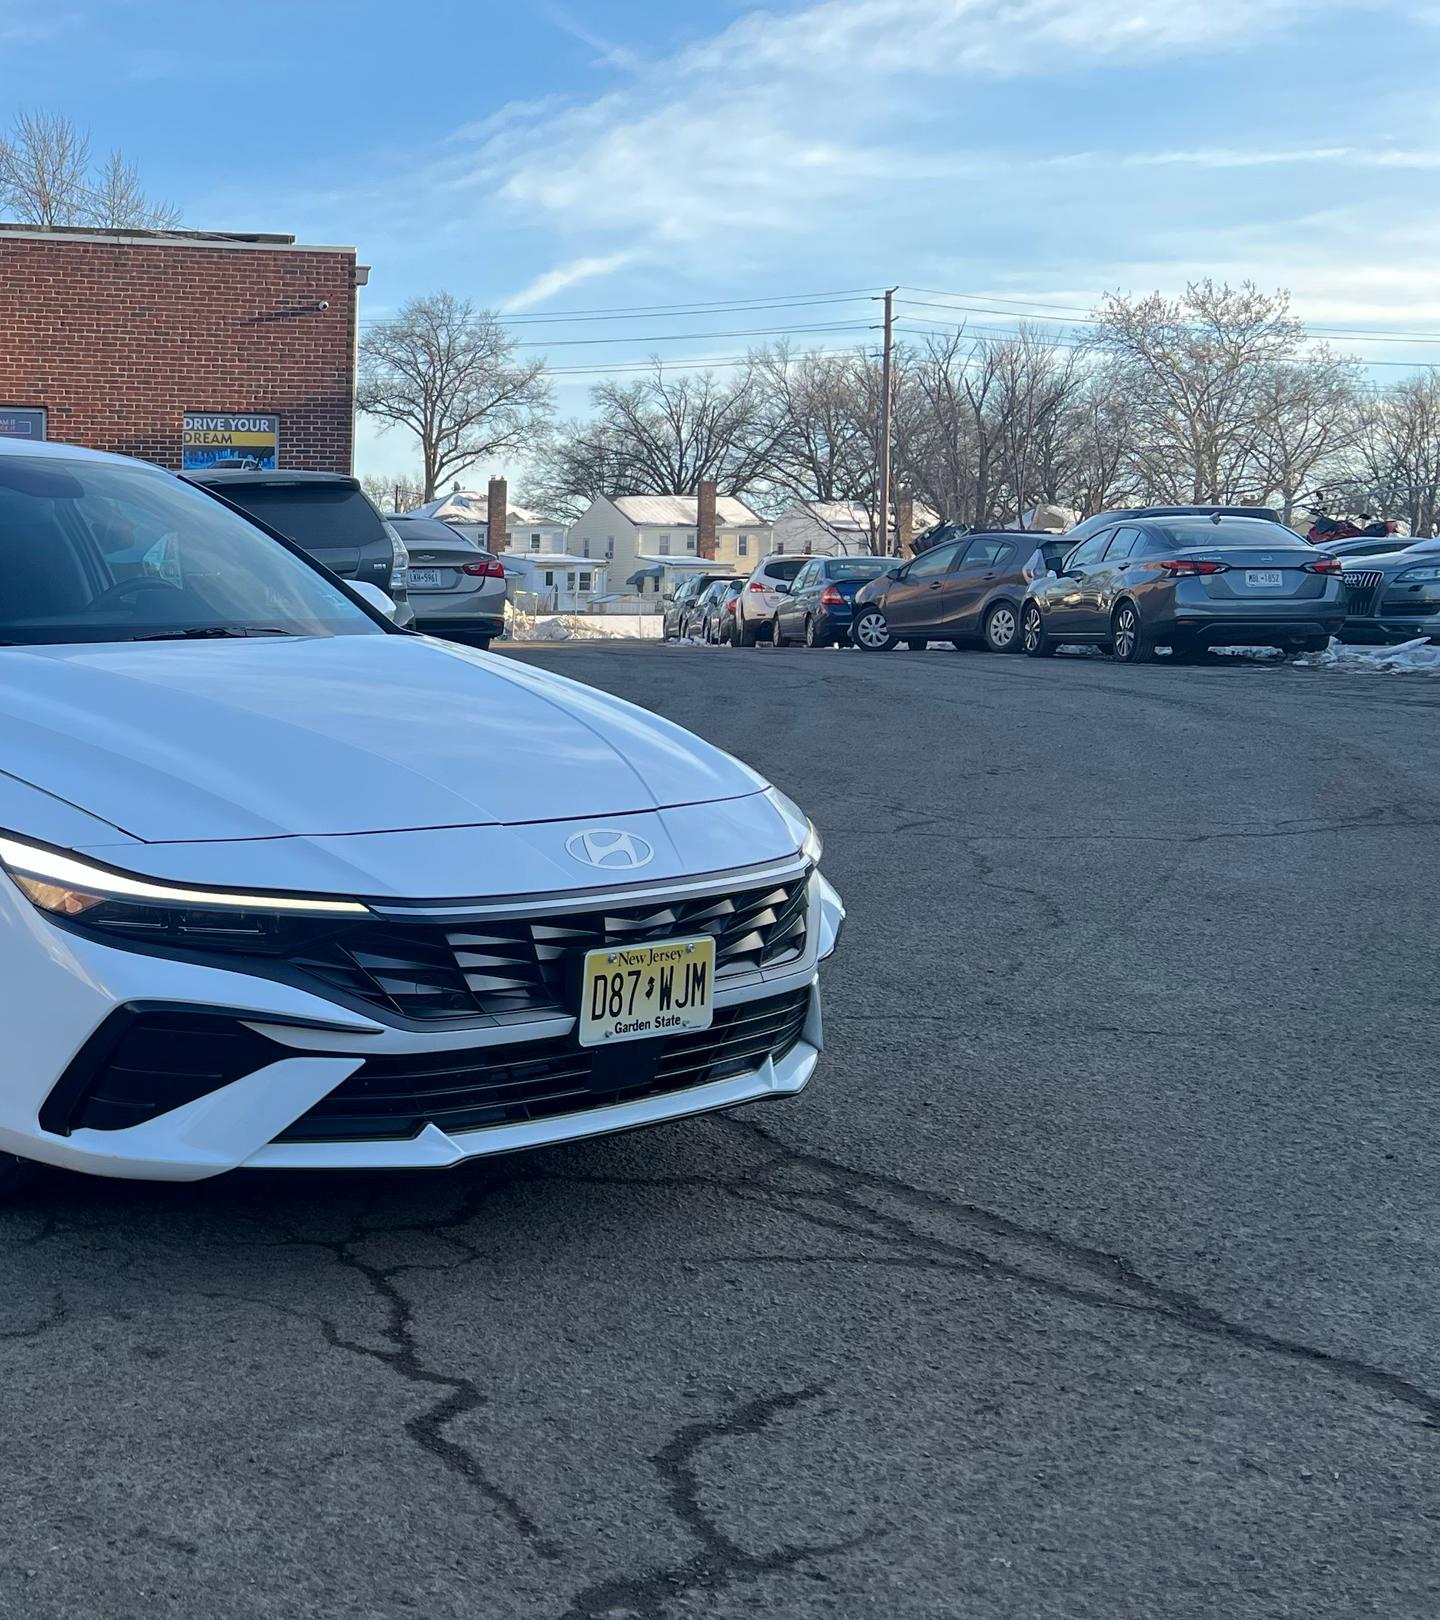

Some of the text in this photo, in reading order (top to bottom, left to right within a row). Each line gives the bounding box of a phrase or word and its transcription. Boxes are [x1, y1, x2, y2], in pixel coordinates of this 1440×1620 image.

[183, 418, 269, 431] DRIVE YOUR
[183, 432, 233, 444] DREAM
[618, 948, 683, 967] New Jersey
[614, 1015, 681, 1034] Garden State
